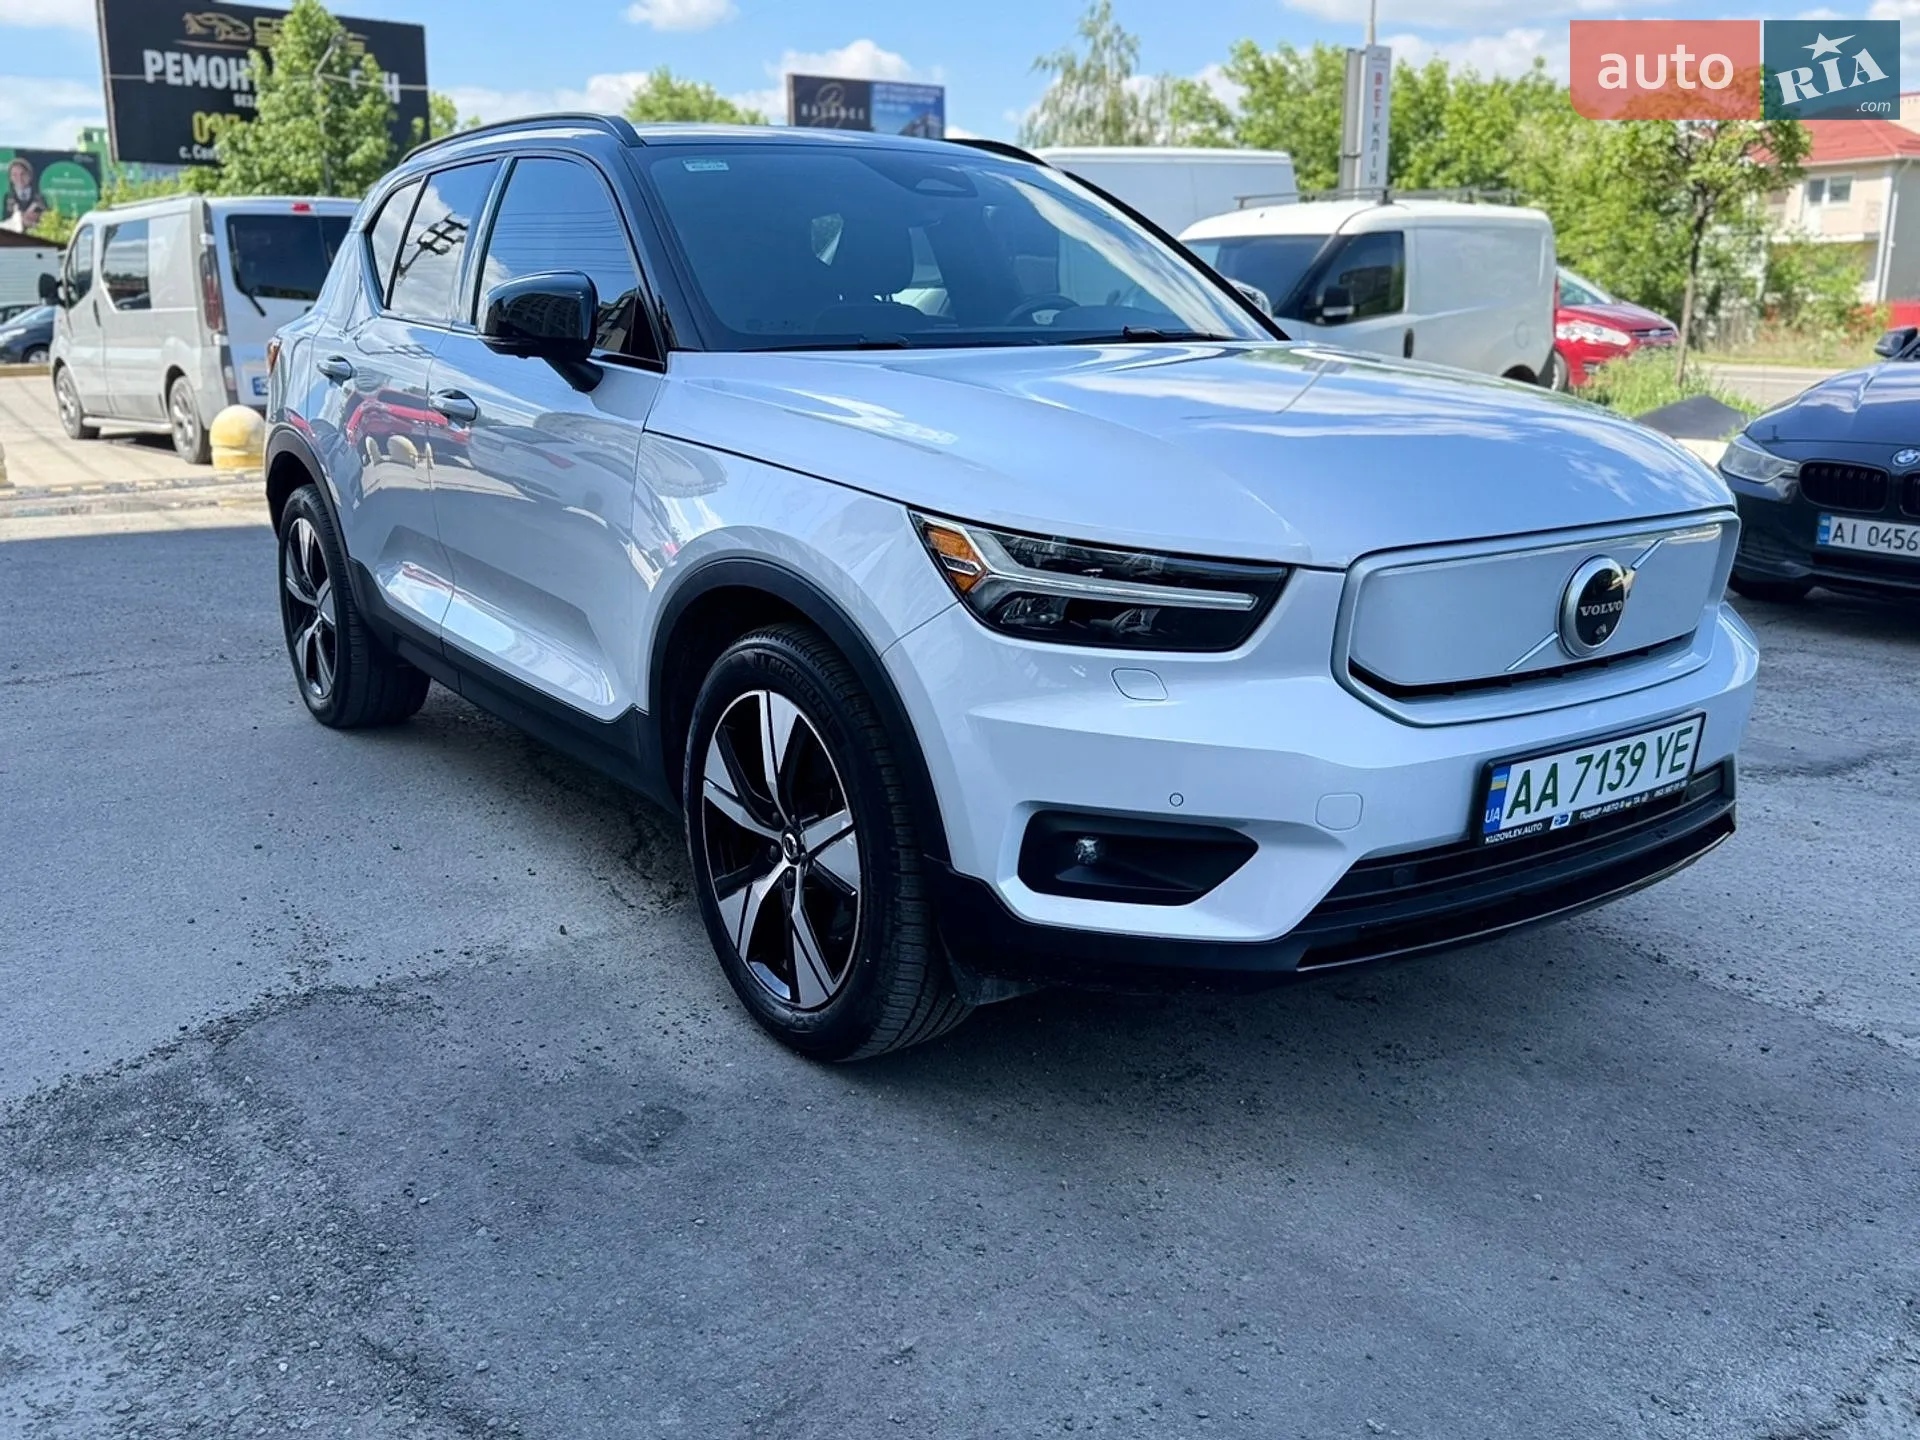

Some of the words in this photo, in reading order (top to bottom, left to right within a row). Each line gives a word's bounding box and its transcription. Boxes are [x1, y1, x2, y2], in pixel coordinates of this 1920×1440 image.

[143, 49, 262, 93] РЕМОН
[1832, 522, 1857, 544] AI
[1867, 526, 1920, 551] 0456
[1580, 600, 1623, 617] VOLVO
[1506, 762, 1559, 820] AA
[1569, 741, 1647, 803] 7139
[1654, 726, 1693, 779] YE
[1485, 807, 1500, 824] UA
